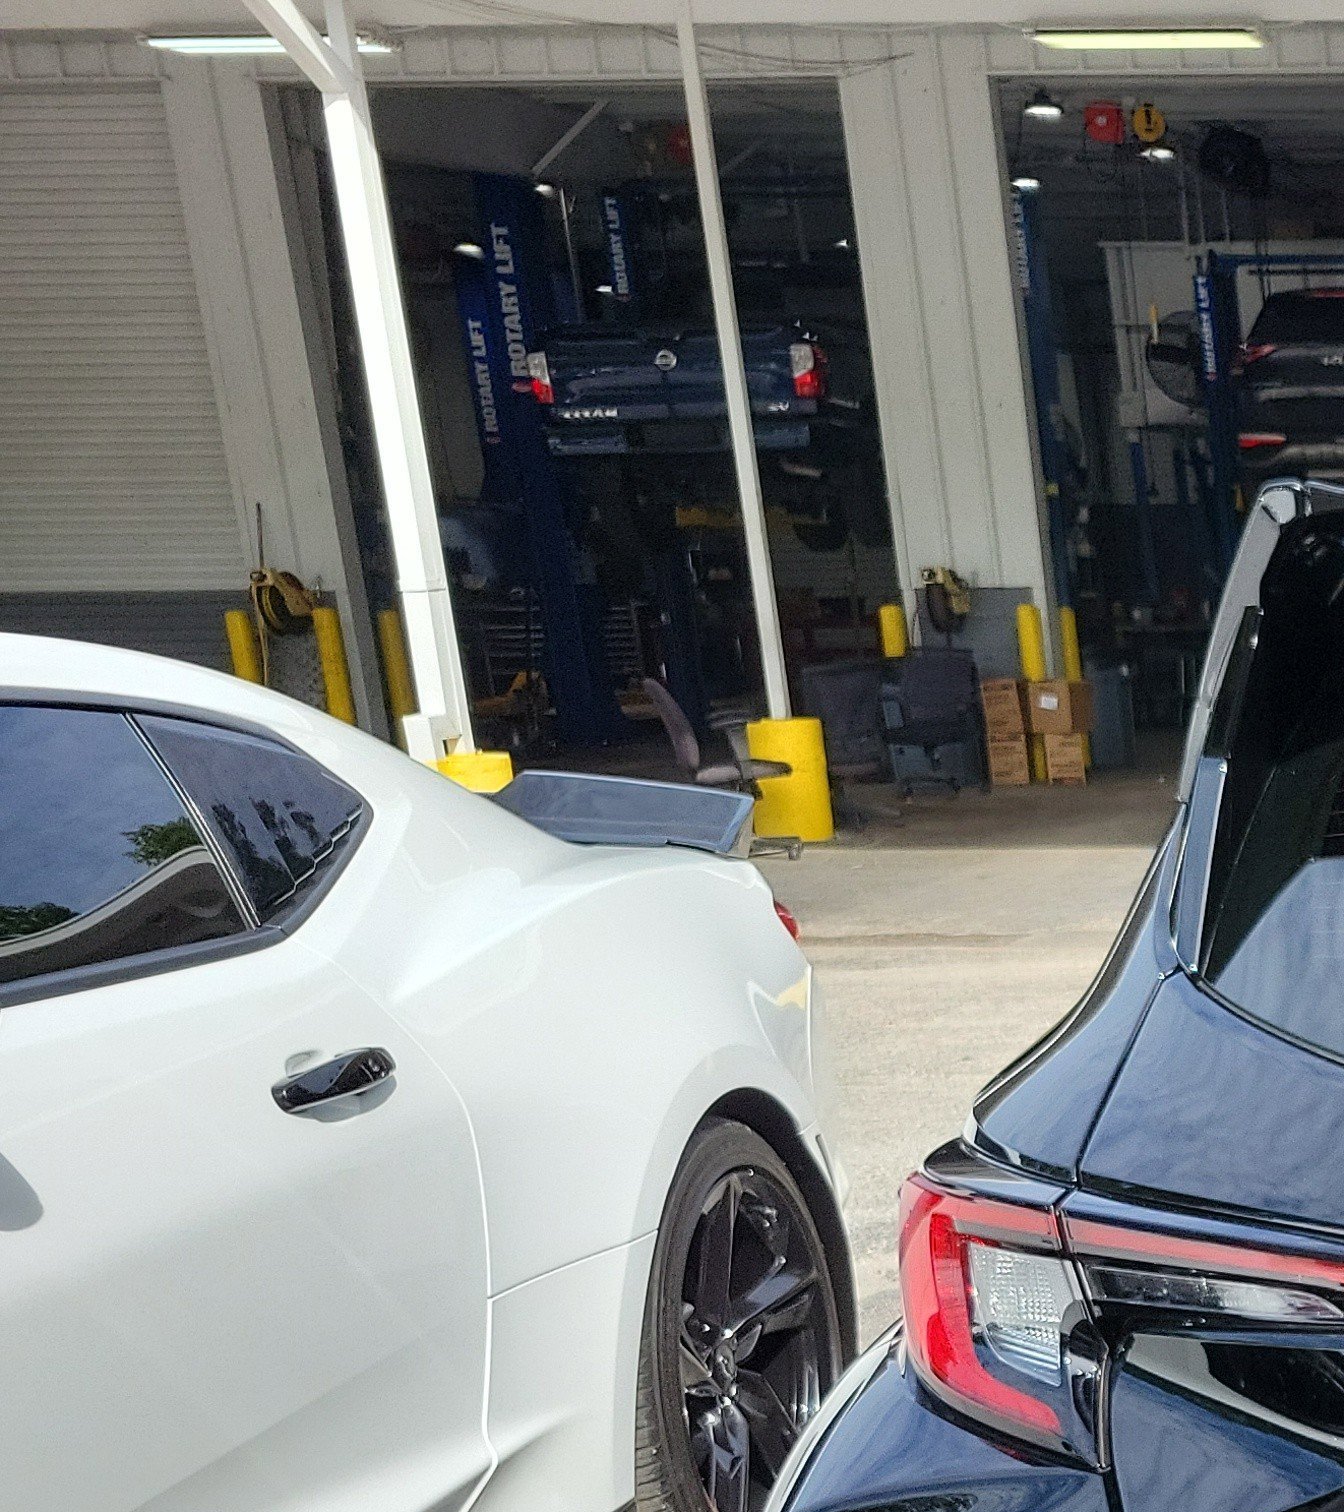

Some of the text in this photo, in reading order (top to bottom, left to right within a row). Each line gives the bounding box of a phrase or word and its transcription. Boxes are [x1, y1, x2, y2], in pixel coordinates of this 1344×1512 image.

[468, 316, 487, 357] LIFT
[490, 222, 530, 377] ROTARY LIFT
